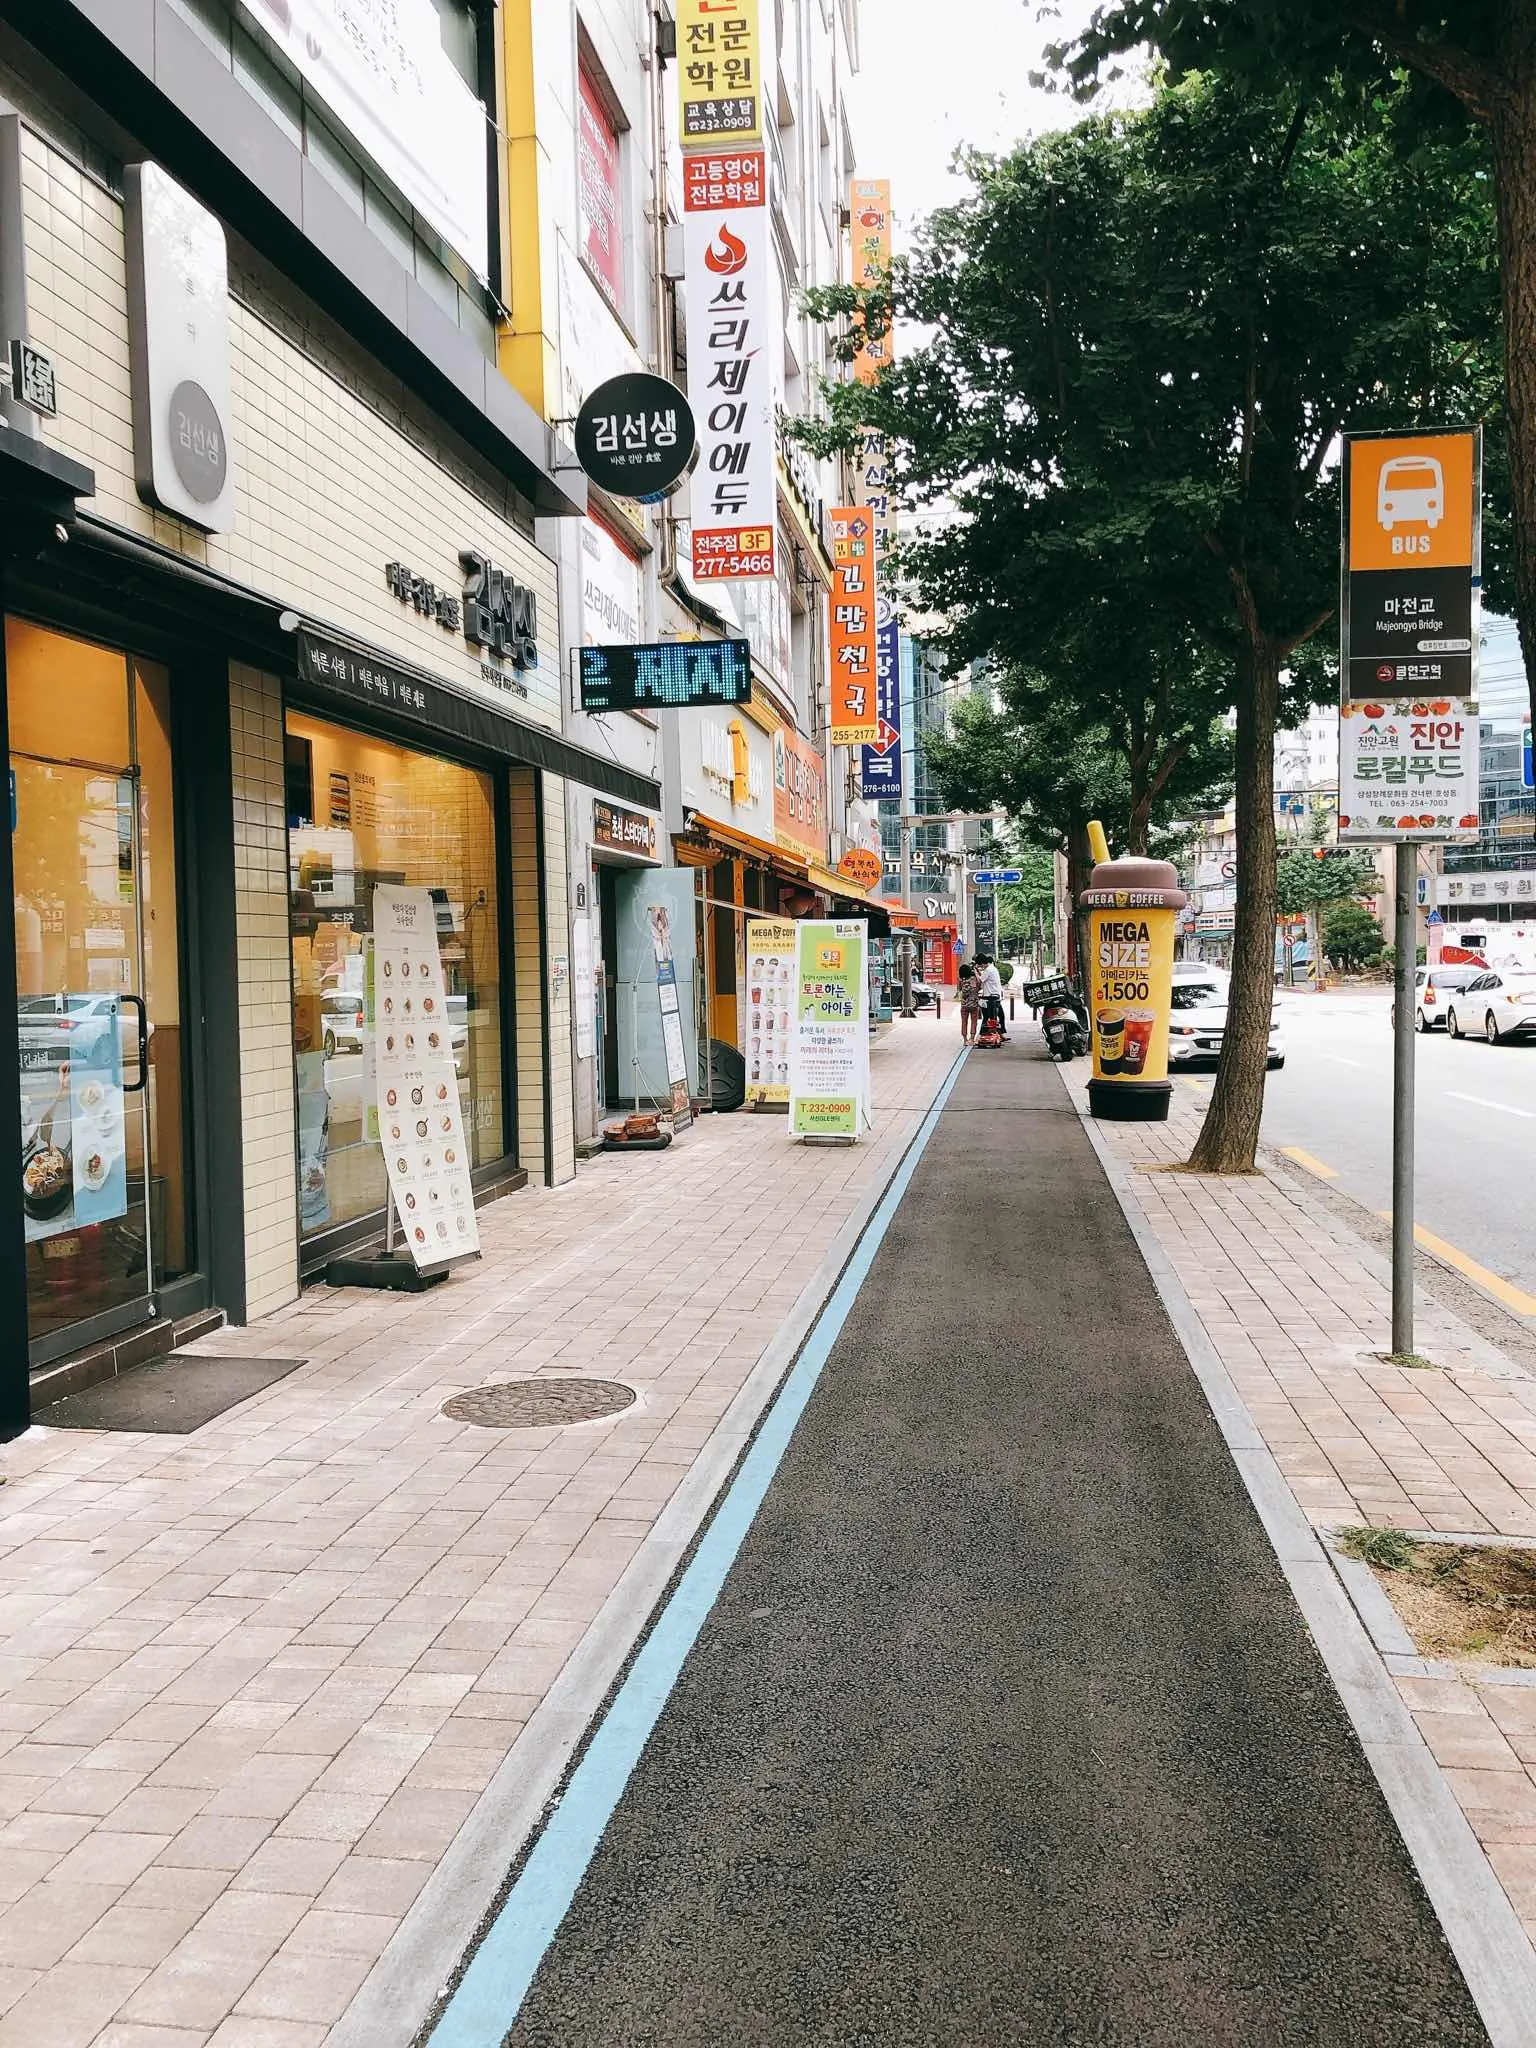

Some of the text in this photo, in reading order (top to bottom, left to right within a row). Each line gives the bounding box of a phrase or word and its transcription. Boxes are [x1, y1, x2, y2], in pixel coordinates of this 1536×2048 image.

[686, 20, 751, 54] 전문
[685, 57, 752, 92] 학원
[688, 100, 752, 117] 교육상담
[699, 116, 752, 131] 232.0909
[690, 157, 760, 181] 고등영어
[690, 179, 760, 205] 전문학원
[706, 280, 751, 516] 쓰리제이에듀
[177, 410, 219, 466] 김선생
[591, 409, 677, 452] 김선생
[695, 534, 738, 555] 전주점
[744, 533, 766, 549] 3F
[1391, 535, 1432, 555] BUS
[695, 554, 771, 577] 277-5466
[458, 550, 538, 670] 김선생
[1383, 597, 1436, 615] 마전교
[1375, 618, 1444, 633] Majeongyo Bridge
[834, 563, 869, 717] 김밥천국
[311, 648, 330, 674] 바른
[1395, 664, 1443, 678] 금연구역
[833, 729, 876, 742] 255-2177
[1357, 735, 1399, 748] 진안고원
[1409, 721, 1465, 751] 진안
[1353, 755, 1465, 785] 로컬푸드
[863, 783, 901, 794] 276-6100
[1368, 799, 1449, 808] TEL 063-254-7003
[1087, 893, 1165, 905] MEGA COFFEE
[751, 928, 772, 937] MEGA
[1099, 922, 1150, 942] MEGA
[1099, 942, 1150, 968] SIZE
[1100, 969, 1150, 981] 아메리카노
[803, 983, 846, 999] 토론하는
[1102, 982, 1149, 1001] 1,500
[821, 1001, 853, 1017] 아이들
[800, 1103, 851, 1113] T.232-0909
